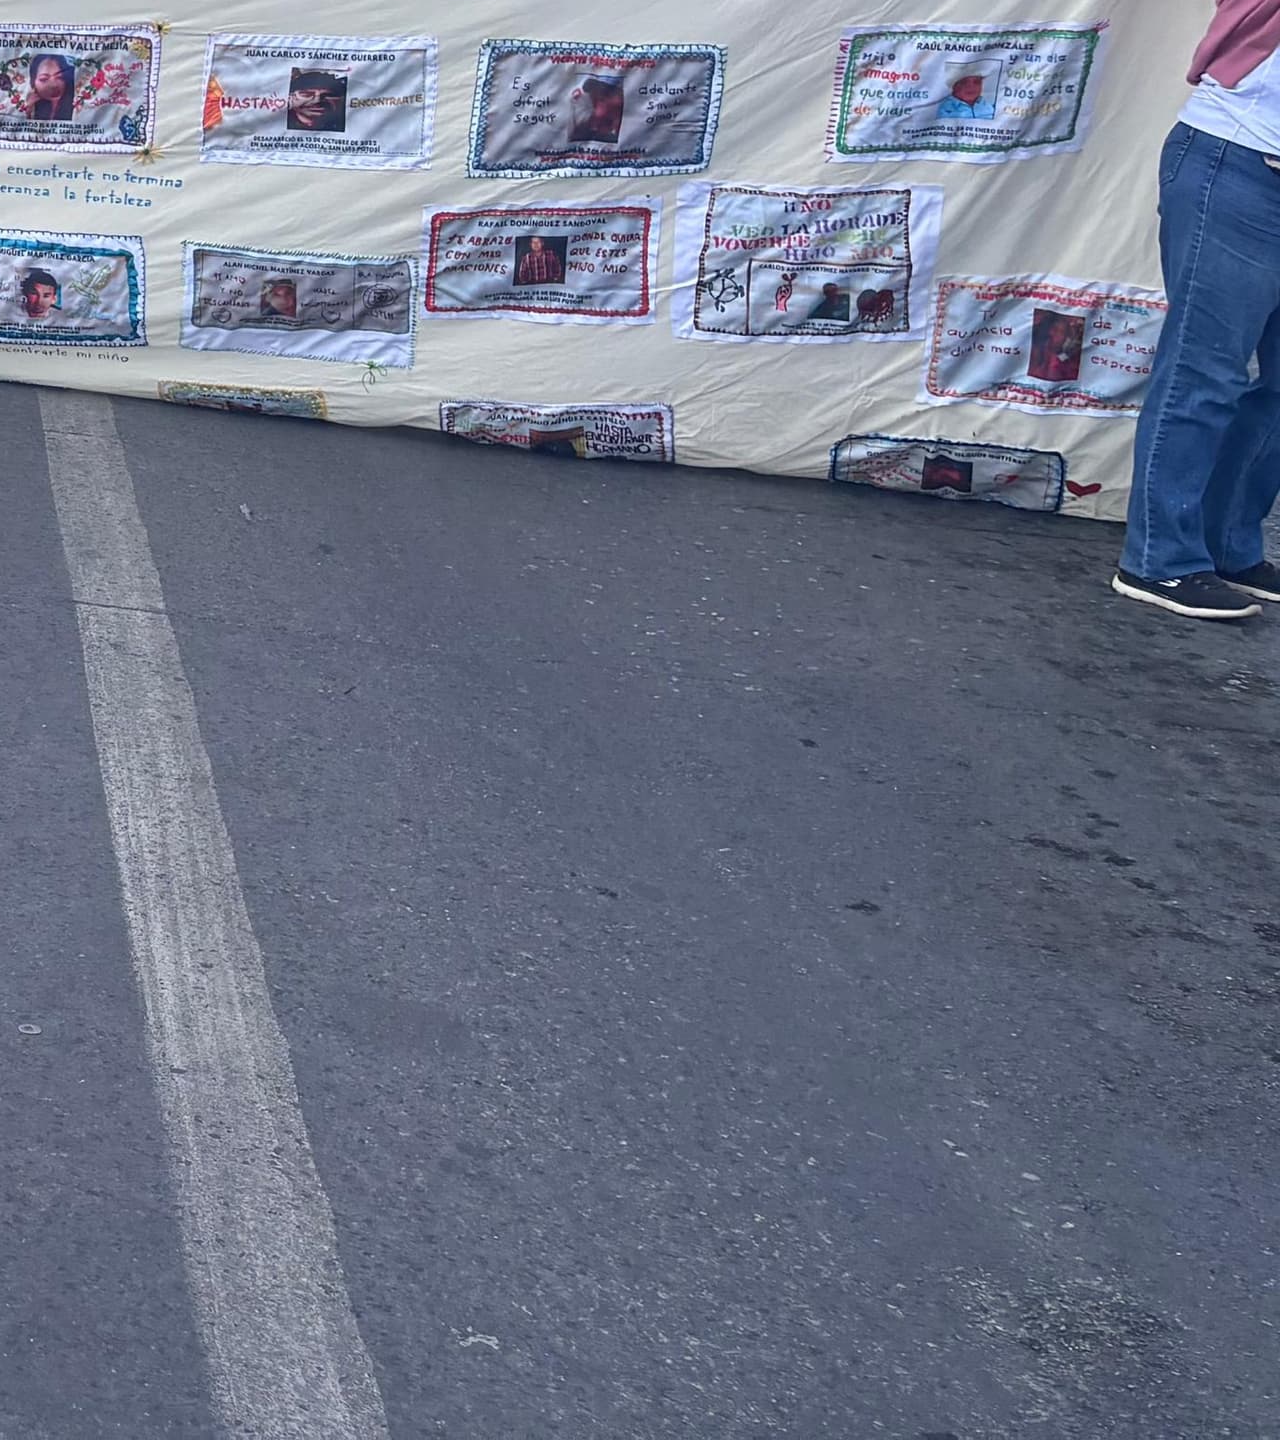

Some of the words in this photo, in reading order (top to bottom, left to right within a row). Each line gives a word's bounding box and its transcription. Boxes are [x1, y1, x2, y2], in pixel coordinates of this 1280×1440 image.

[26, 40, 66, 49] ARACELI
[70, 40, 100, 51] VALLE
[101, 40, 129, 51] MEJÍA
[917, 41, 942, 51] RAÚL
[944, 43, 981, 52] RANGEL
[984, 41, 1035, 51] GONZÁLEZ
[245, 49, 268, 57] JUAN
[271, 51, 306, 59] CARLOS
[308, 49, 348, 60] SÁNCHEZ
[1009, 55, 1019, 65] y
[1025, 54, 1040, 62] un
[513, 77, 530, 91] Es
[638, 84, 697, 95] adelante
[860, 87, 883, 99] que
[887, 88, 928, 99] andas
[221, 97, 270, 109] HASTA
[350, 95, 423, 108] ENCONTRARTE
[877, 105, 912, 116] viaje
[514, 113, 556, 125] seguir
[7, 164, 94, 180] encontrarte
[103, 171, 119, 181] no
[124, 169, 184, 188] termina
[64, 187, 76, 200] la
[85, 191, 152, 207] fortaleza
[478, 220, 508, 228] RAFAEL
[510, 219, 561, 227] DOMÍNGUEZ
[563, 218, 607, 227] SANDOVAL
[445, 251, 470, 259] CON
[570, 248, 590, 256] QUE
[595, 248, 627, 257] ESTES
[224, 261, 242, 269] ALAN
[603, 264, 627, 273] MIO
[1093, 317, 1112, 329] de
[991, 345, 1020, 355] mas
[1091, 337, 1116, 347] que
[1126, 344, 1157, 354] pued
[98, 352, 129, 362] niño
[1091, 356, 1152, 374] expresa
[595, 423, 632, 436] HASTA
[586, 442, 650, 453] HERMANO
